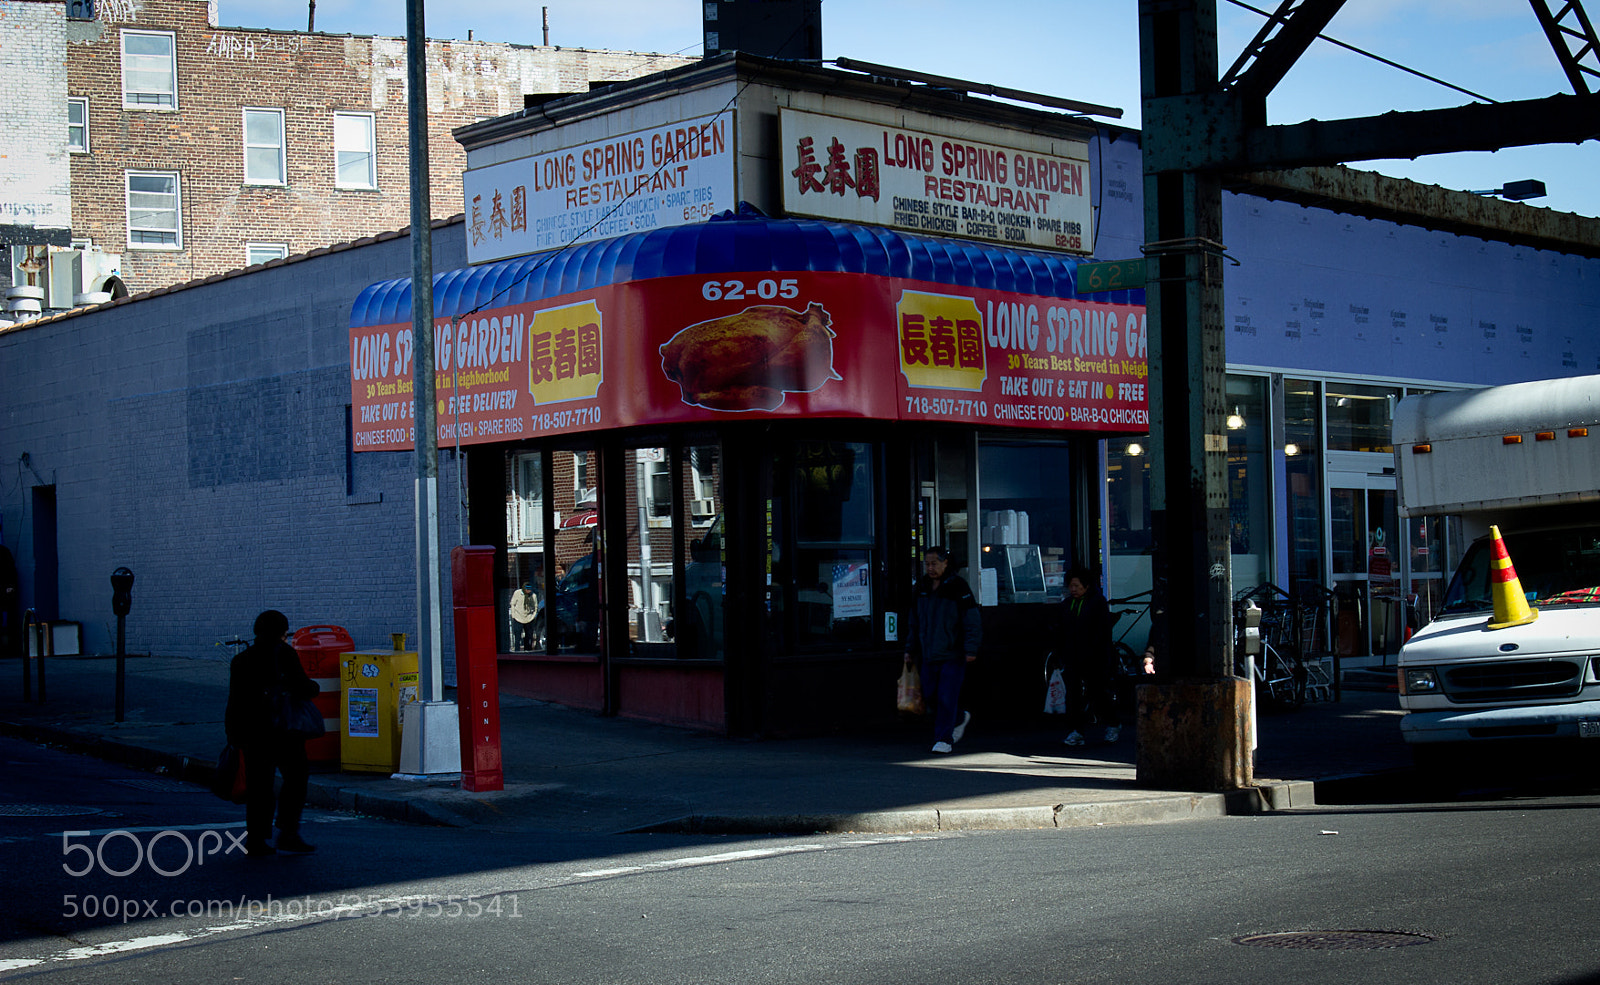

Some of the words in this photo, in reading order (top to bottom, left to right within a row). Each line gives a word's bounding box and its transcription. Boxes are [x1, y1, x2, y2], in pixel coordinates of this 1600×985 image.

[534, 153, 576, 192] LONG
[582, 137, 645, 182] SPRING
[651, 119, 725, 171] GARDEN
[883, 131, 934, 173] LONG
[941, 141, 1008, 185] SPRING
[1013, 153, 1083, 197] GARDEN
[792, 136, 880, 204] 長春園
[566, 165, 689, 210] RESTAURANT
[924, 175, 1050, 215] RESTAURANT
[625, 196, 660, 217] CHICKEN
[694, 185, 712, 204] RIBS
[683, 201, 715, 221] 62-05
[468, 184, 527, 247] 長春園
[634, 212, 657, 230] SODA
[893, 196, 929, 214] CHINESE
[932, 202, 958, 219] STYLE
[962, 207, 995, 225] BAR-B-Q
[997, 212, 1031, 229] CHICKEN
[1037, 217, 1061, 233] SPARE
[1063, 221, 1081, 235] RIBS
[894, 211, 919, 228] FRIED
[921, 215, 957, 232] CHICKEN
[966, 221, 998, 238] COFFEE
[1005, 227, 1026, 242] SODA
[1055, 234, 1081, 249] 62-05
[1089, 265, 1122, 288] 62
[702, 279, 799, 301] 62-05
[902, 312, 983, 371] 長春園
[987, 300, 1039, 351] LONG
[1046, 306, 1119, 358] SPRING
[353, 332, 390, 381] LONG
[457, 313, 524, 370] GARDEN
[531, 322, 601, 385] 長春園
[1007, 353, 1020, 370] 30
[1021, 353, 1049, 370] Years
[1050, 355, 1072, 372] Best
[1074, 357, 1107, 374] Served
[1109, 359, 1120, 375] in
[366, 384, 376, 399] 30
[377, 381, 396, 397] Years
[397, 378, 413, 394] Best
[442, 374, 451, 389] in
[1000, 376, 1028, 397] TAKE
[1032, 378, 1054, 398] OUT
[1057, 379, 1065, 398] &
[1068, 380, 1088, 399] EAT
[1091, 381, 1104, 399] IN
[1118, 383, 1144, 402] FREE
[360, 404, 380, 424] TAKE
[382, 402, 399, 421] OUT
[400, 401, 406, 419] &
[473, 389, 518, 414] DELIVERY
[905, 395, 987, 417] 718-507-7710
[994, 402, 1036, 420] CHINESE
[1038, 405, 1065, 422] FOOD
[1070, 407, 1108, 424] BAR-B-Q
[1109, 408, 1149, 425] CHICKEN
[440, 421, 474, 440] CHICKEN
[478, 418, 503, 436] SPARE
[504, 417, 523, 433] RIBS
[532, 406, 602, 431] 718-507-7710
[355, 430, 385, 446] CHINESE
[386, 428, 406, 444] FOOD
[888, 616, 896, 633] B
